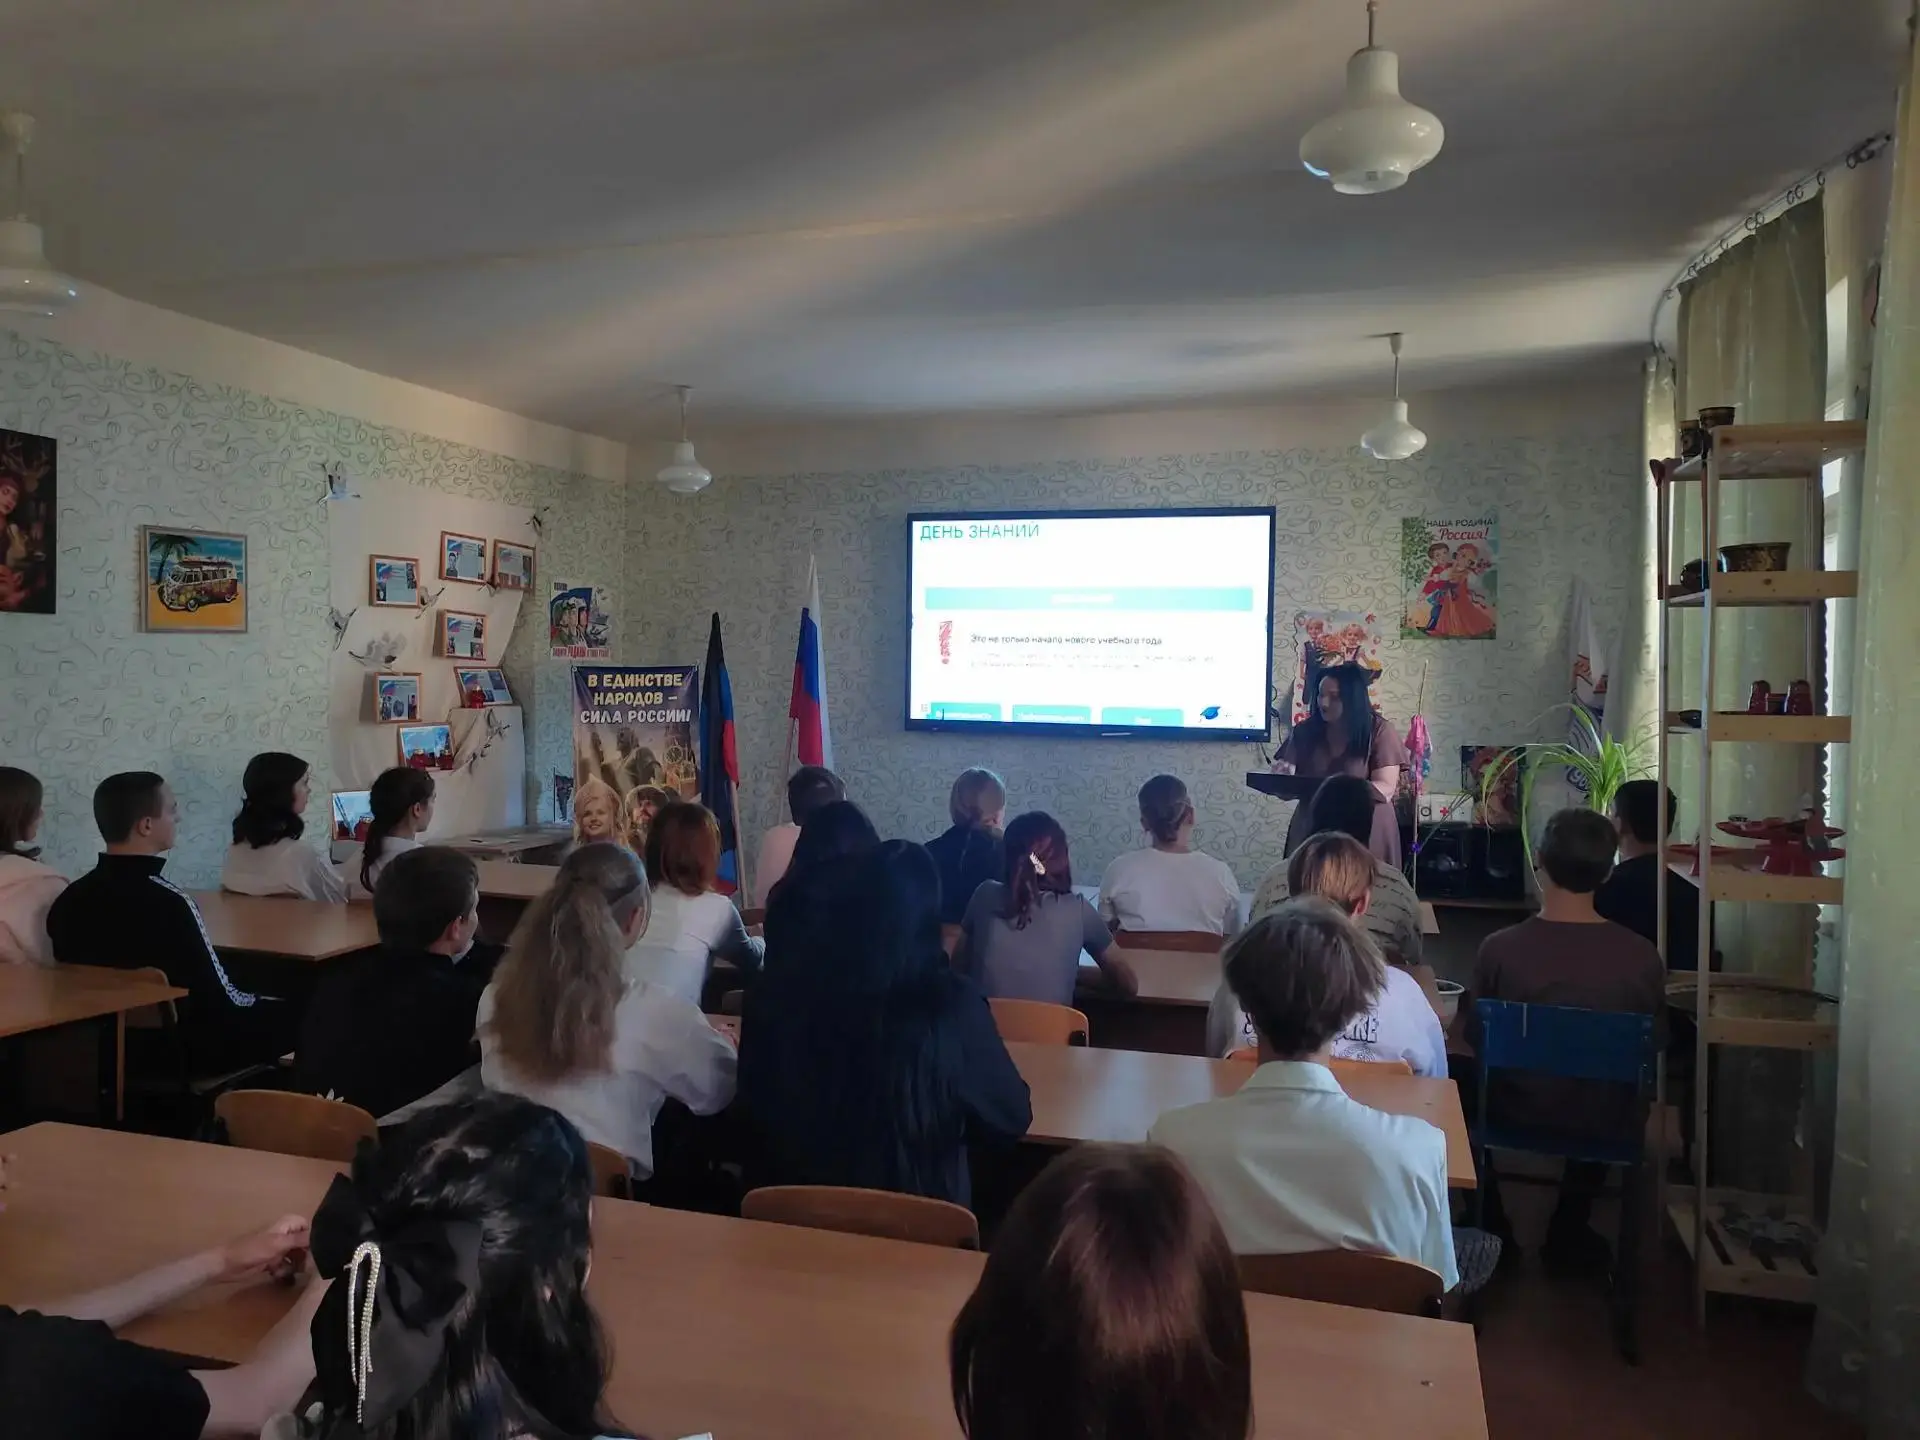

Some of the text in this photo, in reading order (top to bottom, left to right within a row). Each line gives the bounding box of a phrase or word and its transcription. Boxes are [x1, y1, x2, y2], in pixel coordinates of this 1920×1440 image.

[1426, 518, 1493, 527] НАША РОДИНА
[920, 522, 1039, 540] ДЕНЬ ЗНАНИЙ
[1439, 527, 1489, 540] Россия!
[587, 673, 683, 689] В ЕДИНСТВЕ
[593, 691, 664, 707] НАРОДОВ
[580, 709, 692, 723] СИЛА РОССИИ!
